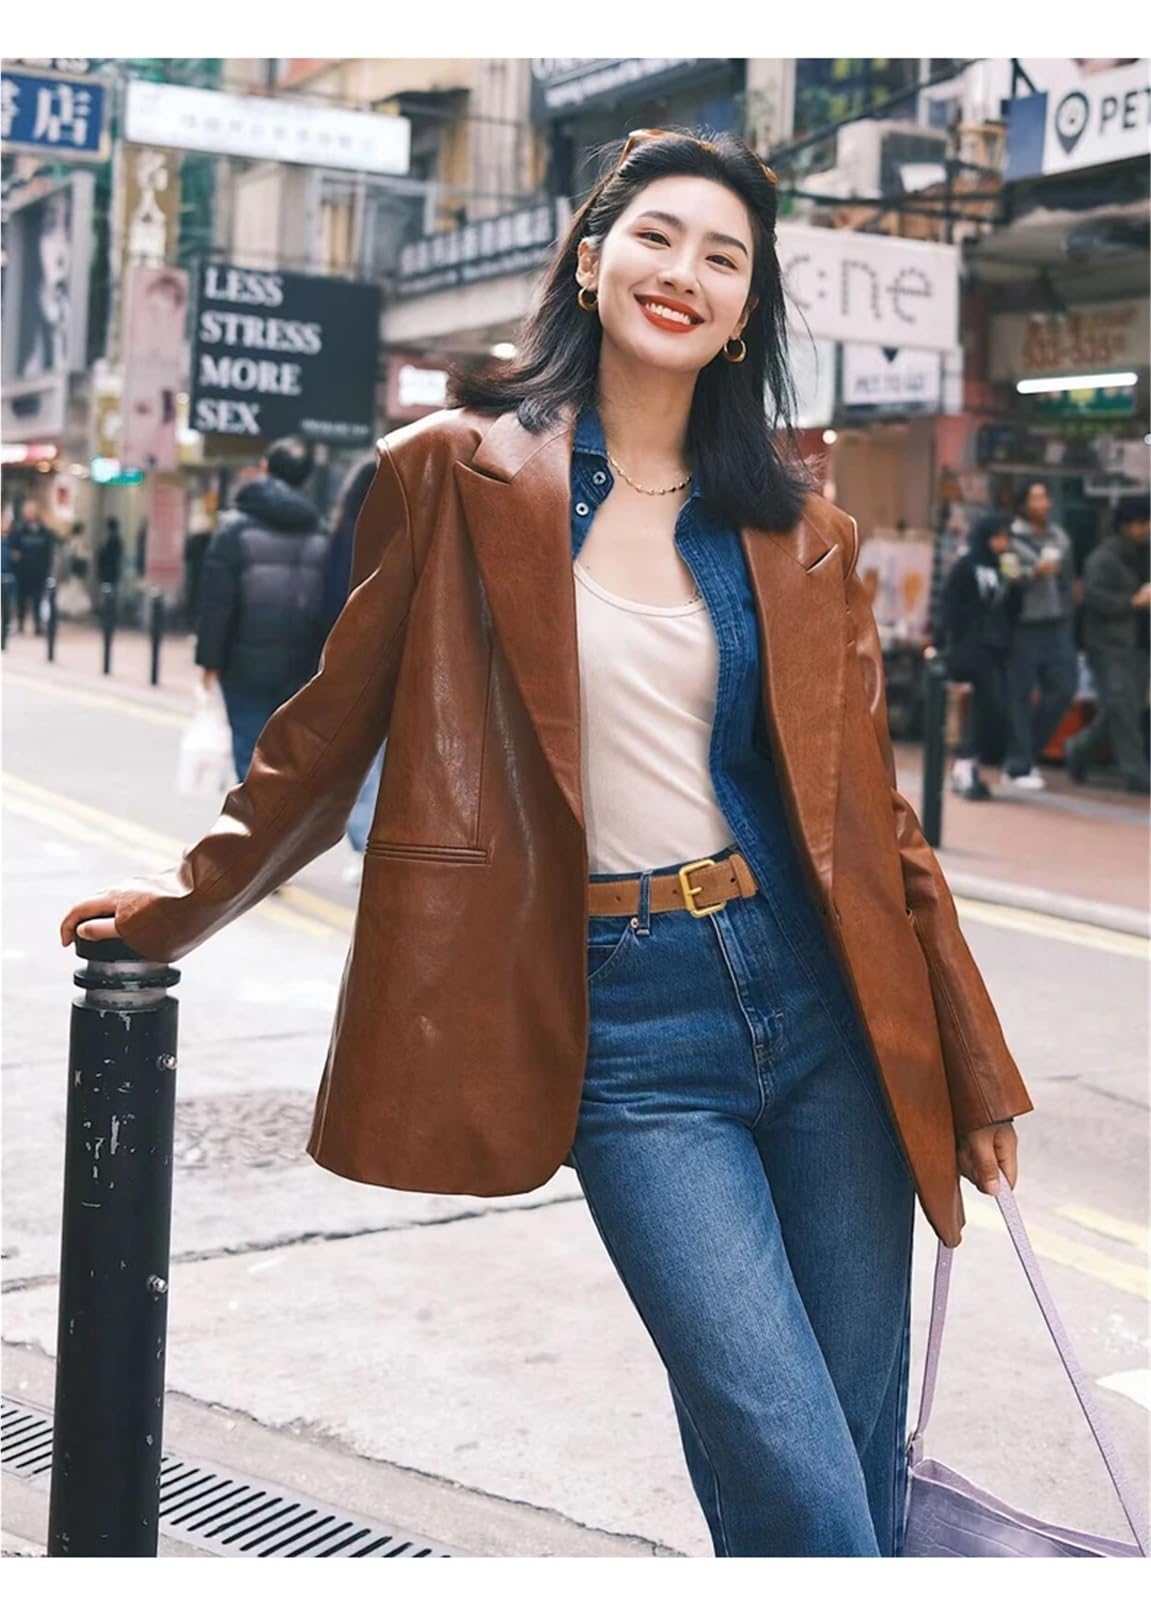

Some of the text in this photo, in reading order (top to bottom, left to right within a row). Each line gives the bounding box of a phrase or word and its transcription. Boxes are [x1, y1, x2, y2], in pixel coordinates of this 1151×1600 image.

[204, 266, 285, 308] LESS
[200, 310, 323, 356] STRESS
[200, 354, 302, 397] MORE
[195, 398, 260, 436] SEX
